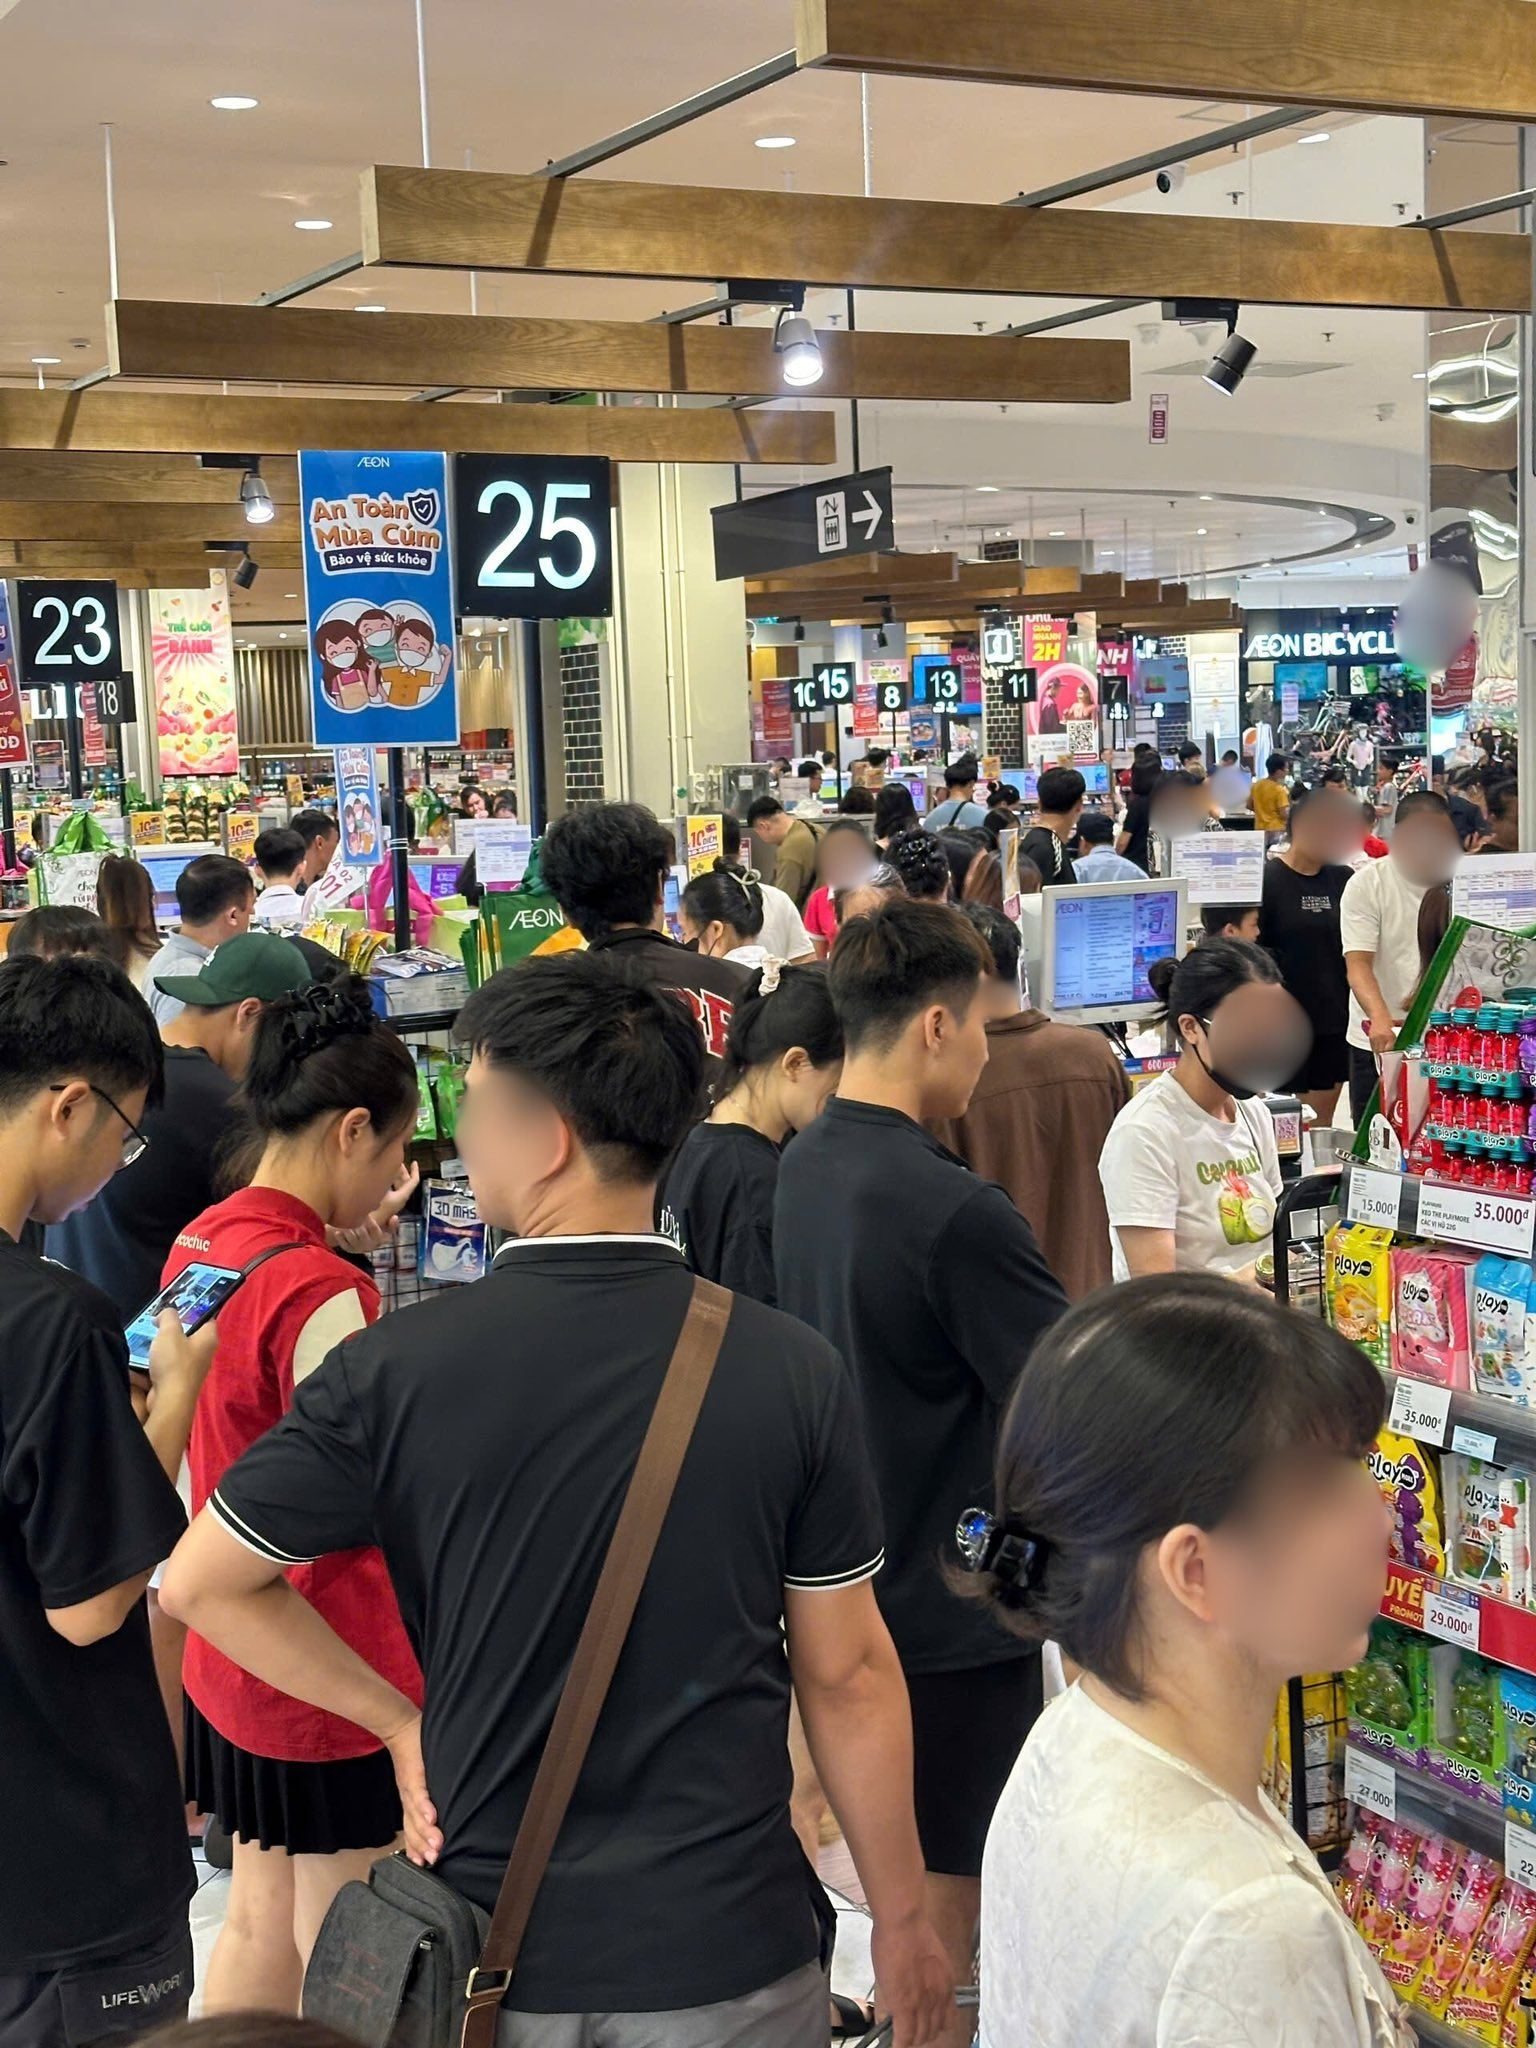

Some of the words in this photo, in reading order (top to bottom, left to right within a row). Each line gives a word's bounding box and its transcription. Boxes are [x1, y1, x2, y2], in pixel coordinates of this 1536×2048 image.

[314, 501, 347, 523] An
[352, 496, 410, 520] Toàn
[315, 522, 374, 550] Mùa
[382, 523, 440, 549] Cúm
[477, 480, 596, 590] 25
[329, 553, 354, 566] Bảo
[356, 552, 372, 566] vệ
[374, 551, 395, 563] sức
[398, 552, 428, 566] khỏe
[32, 596, 112, 665] 23
[1032, 642, 1061, 661] 2H
[818, 668, 849, 699] 15
[884, 685, 901, 709] 8
[930, 670, 959, 698] 13
[1008, 673, 1028, 698] 11
[1108, 680, 1121, 700] 7
[98, 681, 119, 715] 18
